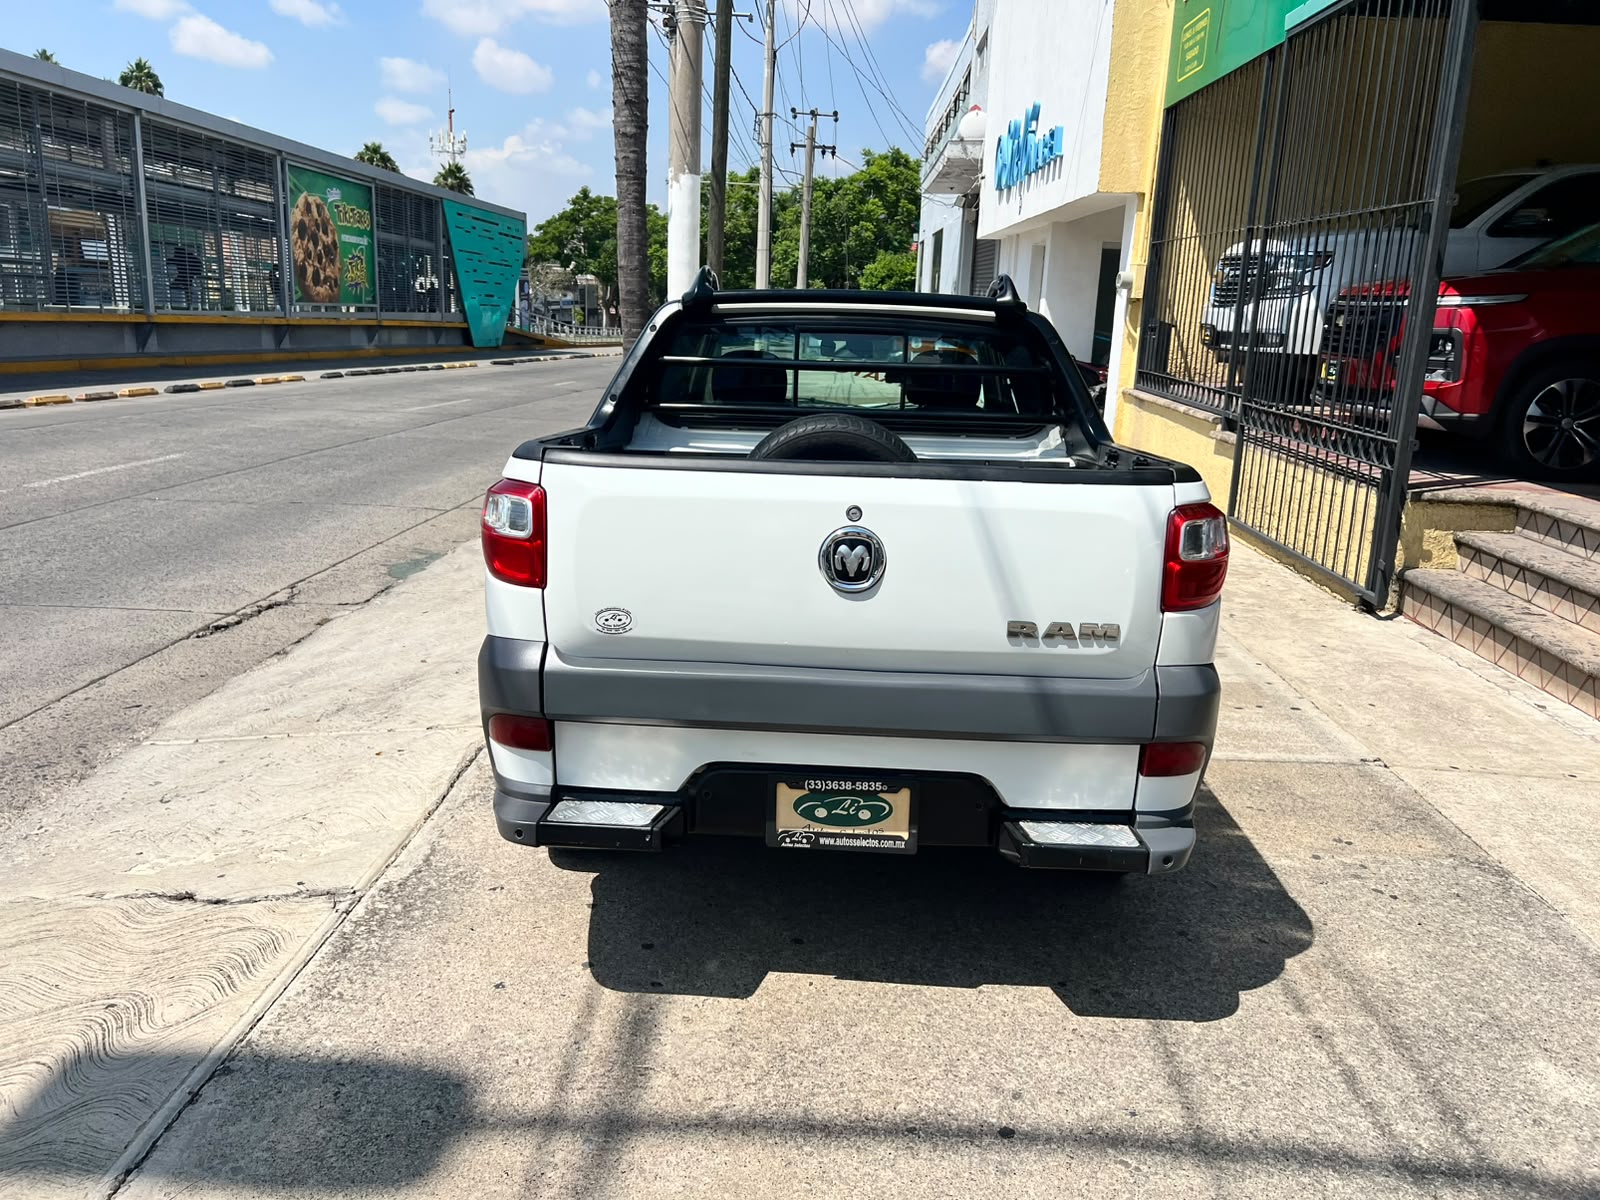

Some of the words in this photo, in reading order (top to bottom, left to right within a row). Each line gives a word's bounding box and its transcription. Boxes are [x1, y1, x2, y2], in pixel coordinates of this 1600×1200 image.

[1007, 620, 1121, 641] RAM
[831, 799, 858, 815] Li
[819, 836, 906, 849] www.autosselectos.com.mx
